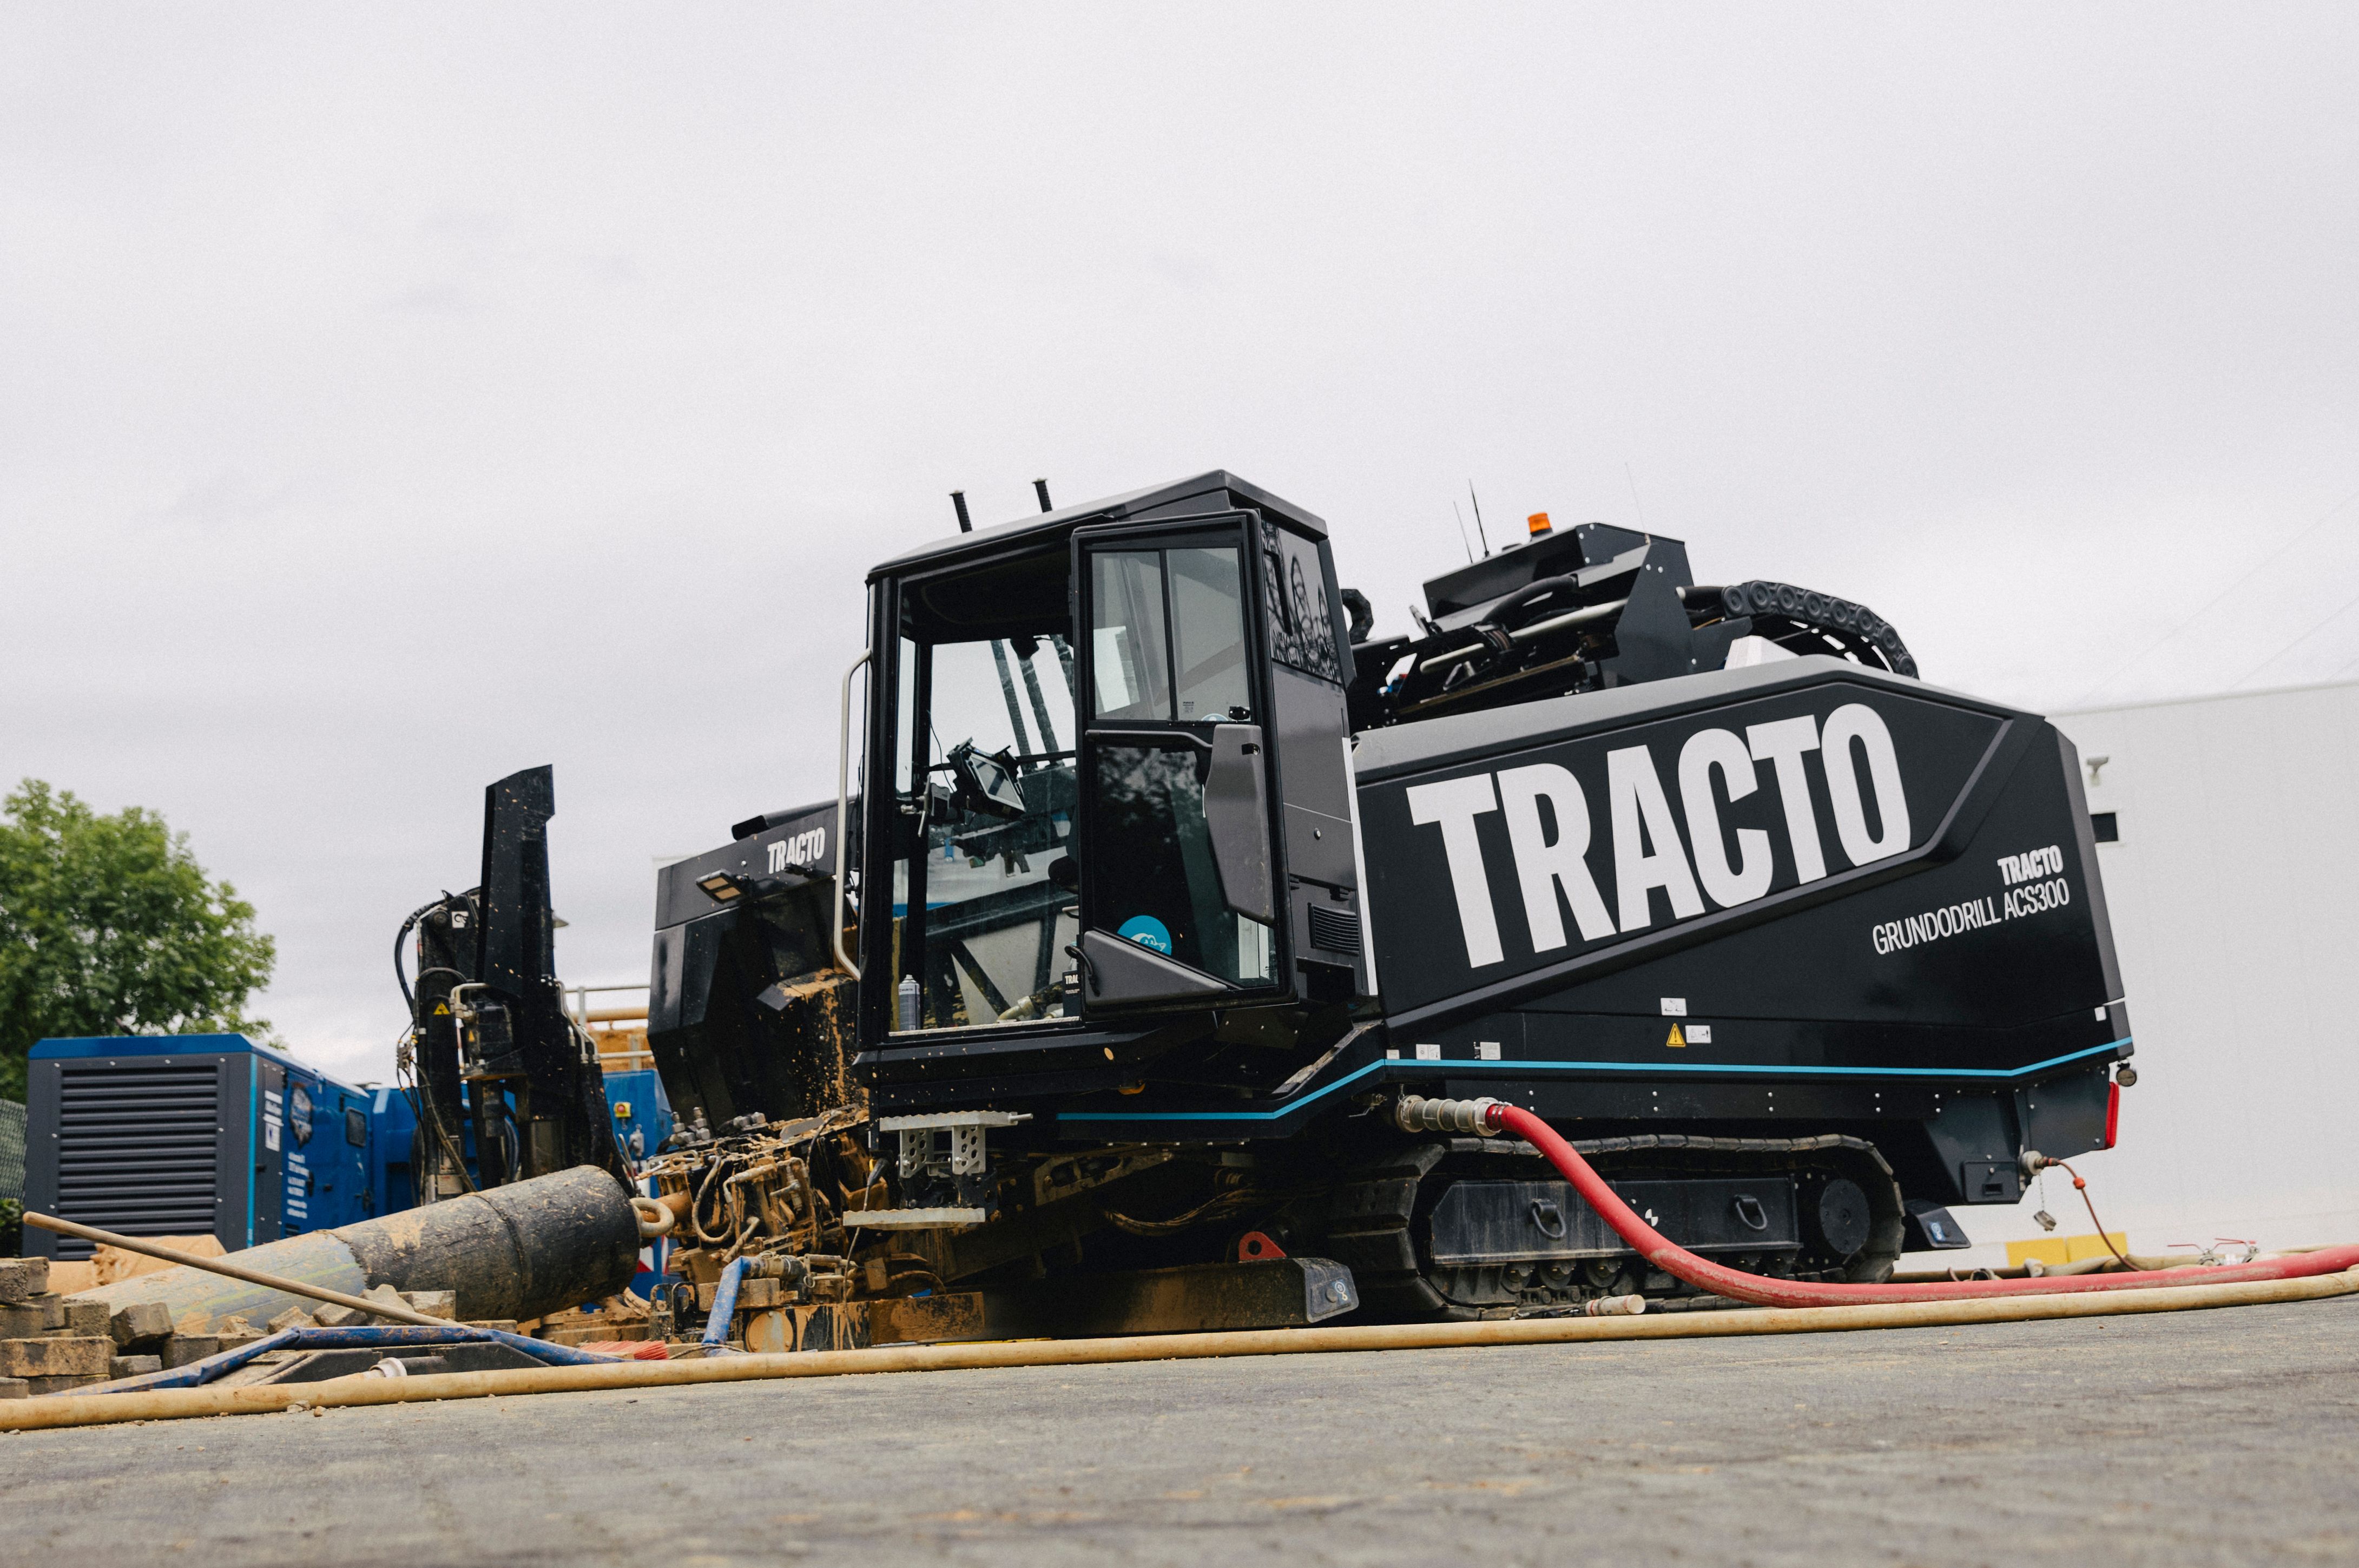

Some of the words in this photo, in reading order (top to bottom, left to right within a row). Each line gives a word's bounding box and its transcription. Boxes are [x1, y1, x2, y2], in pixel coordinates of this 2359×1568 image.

[767, 827, 826, 874] TRACTO
[1406, 703, 1911, 969] TRACTO
[1997, 845, 2064, 886] TRACTO
[1873, 896, 2002, 955] GRUNDODRILL
[2004, 878, 2070, 921] ACS300
